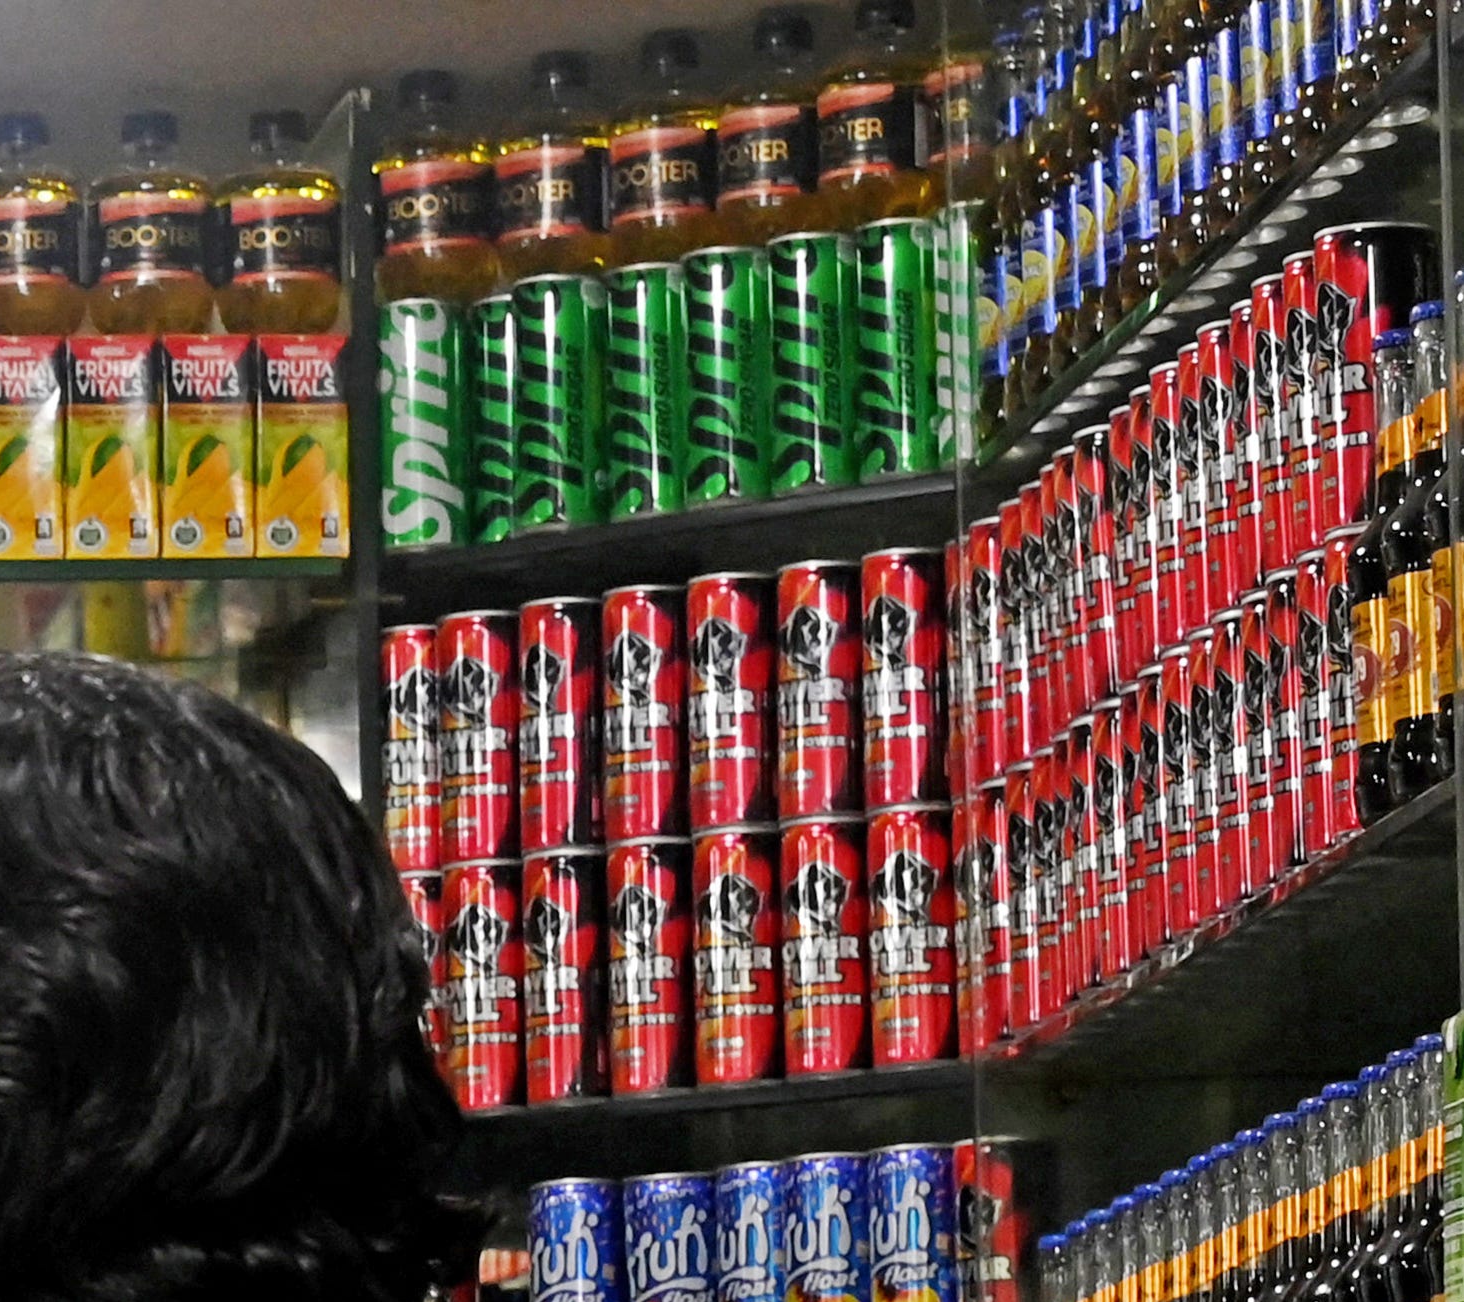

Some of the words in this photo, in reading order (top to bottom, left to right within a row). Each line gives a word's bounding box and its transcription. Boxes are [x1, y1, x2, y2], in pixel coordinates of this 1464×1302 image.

[267, 360, 334, 377] FRUITA
[268, 379, 335, 397] VITALS
[380, 302, 451, 544] Sprite
[803, 1268, 859, 1294] float
